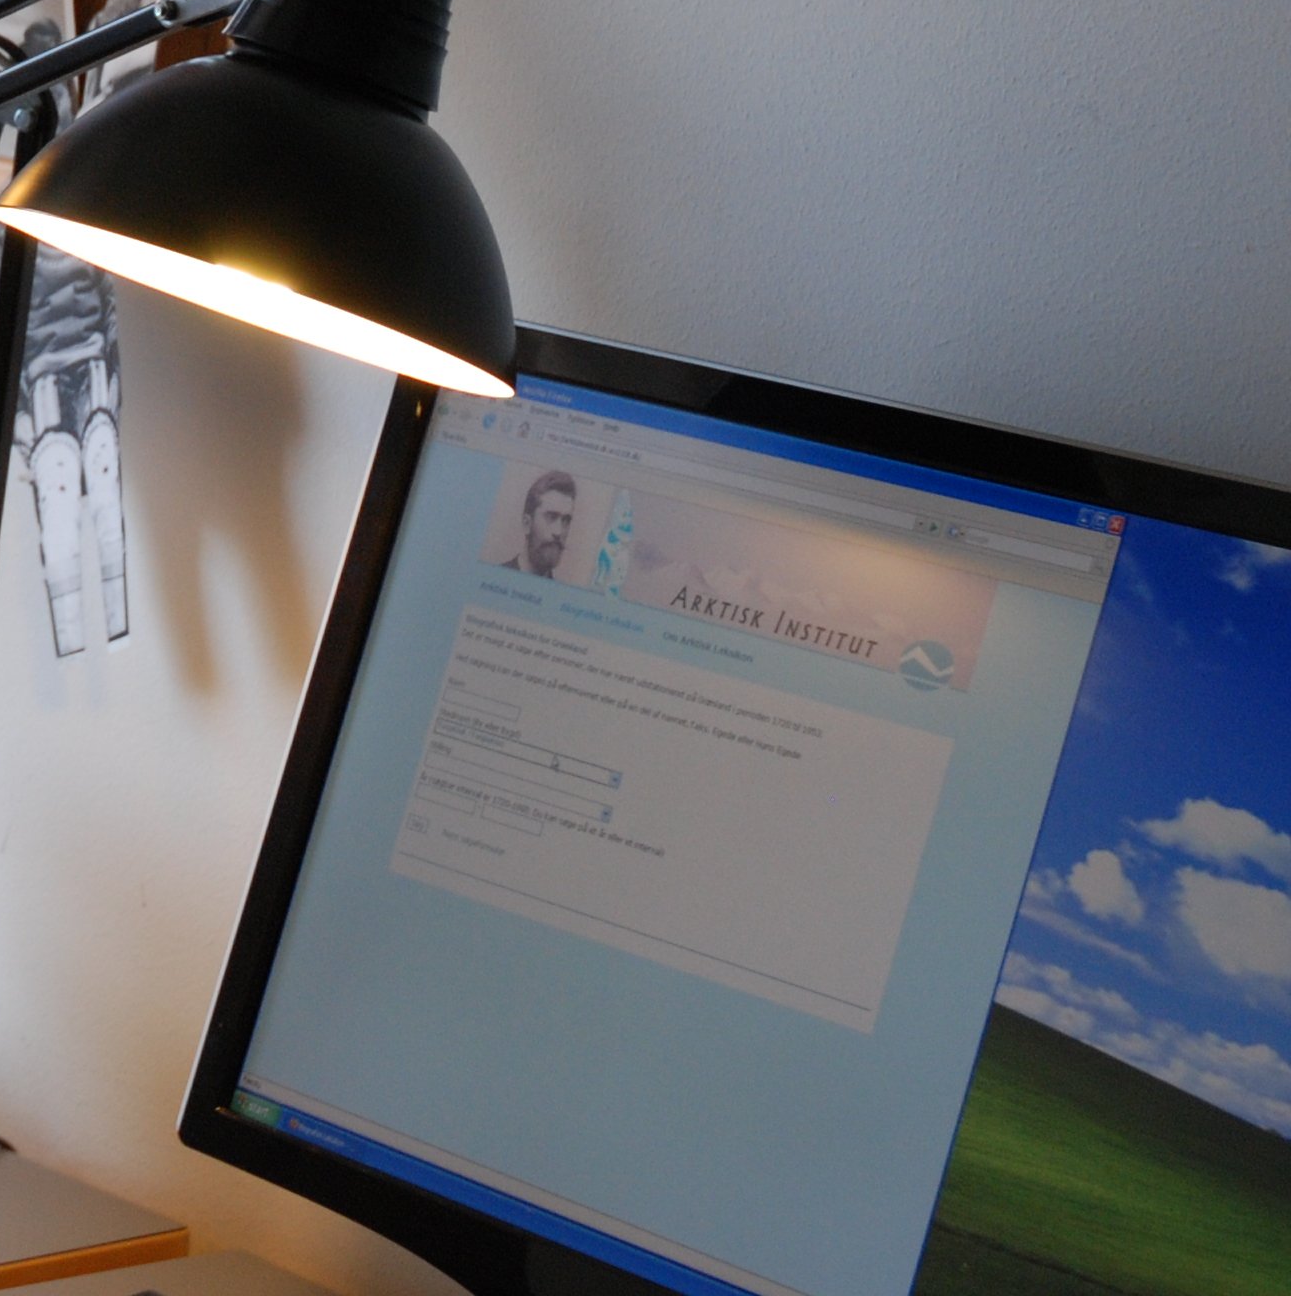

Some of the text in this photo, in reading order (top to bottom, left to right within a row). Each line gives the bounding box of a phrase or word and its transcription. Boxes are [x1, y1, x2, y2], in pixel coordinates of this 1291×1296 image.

[479, 581, 543, 606] Arktisk Institut
[679, 635, 711, 651] Arktisk
[711, 643, 754, 663] Leksikon
